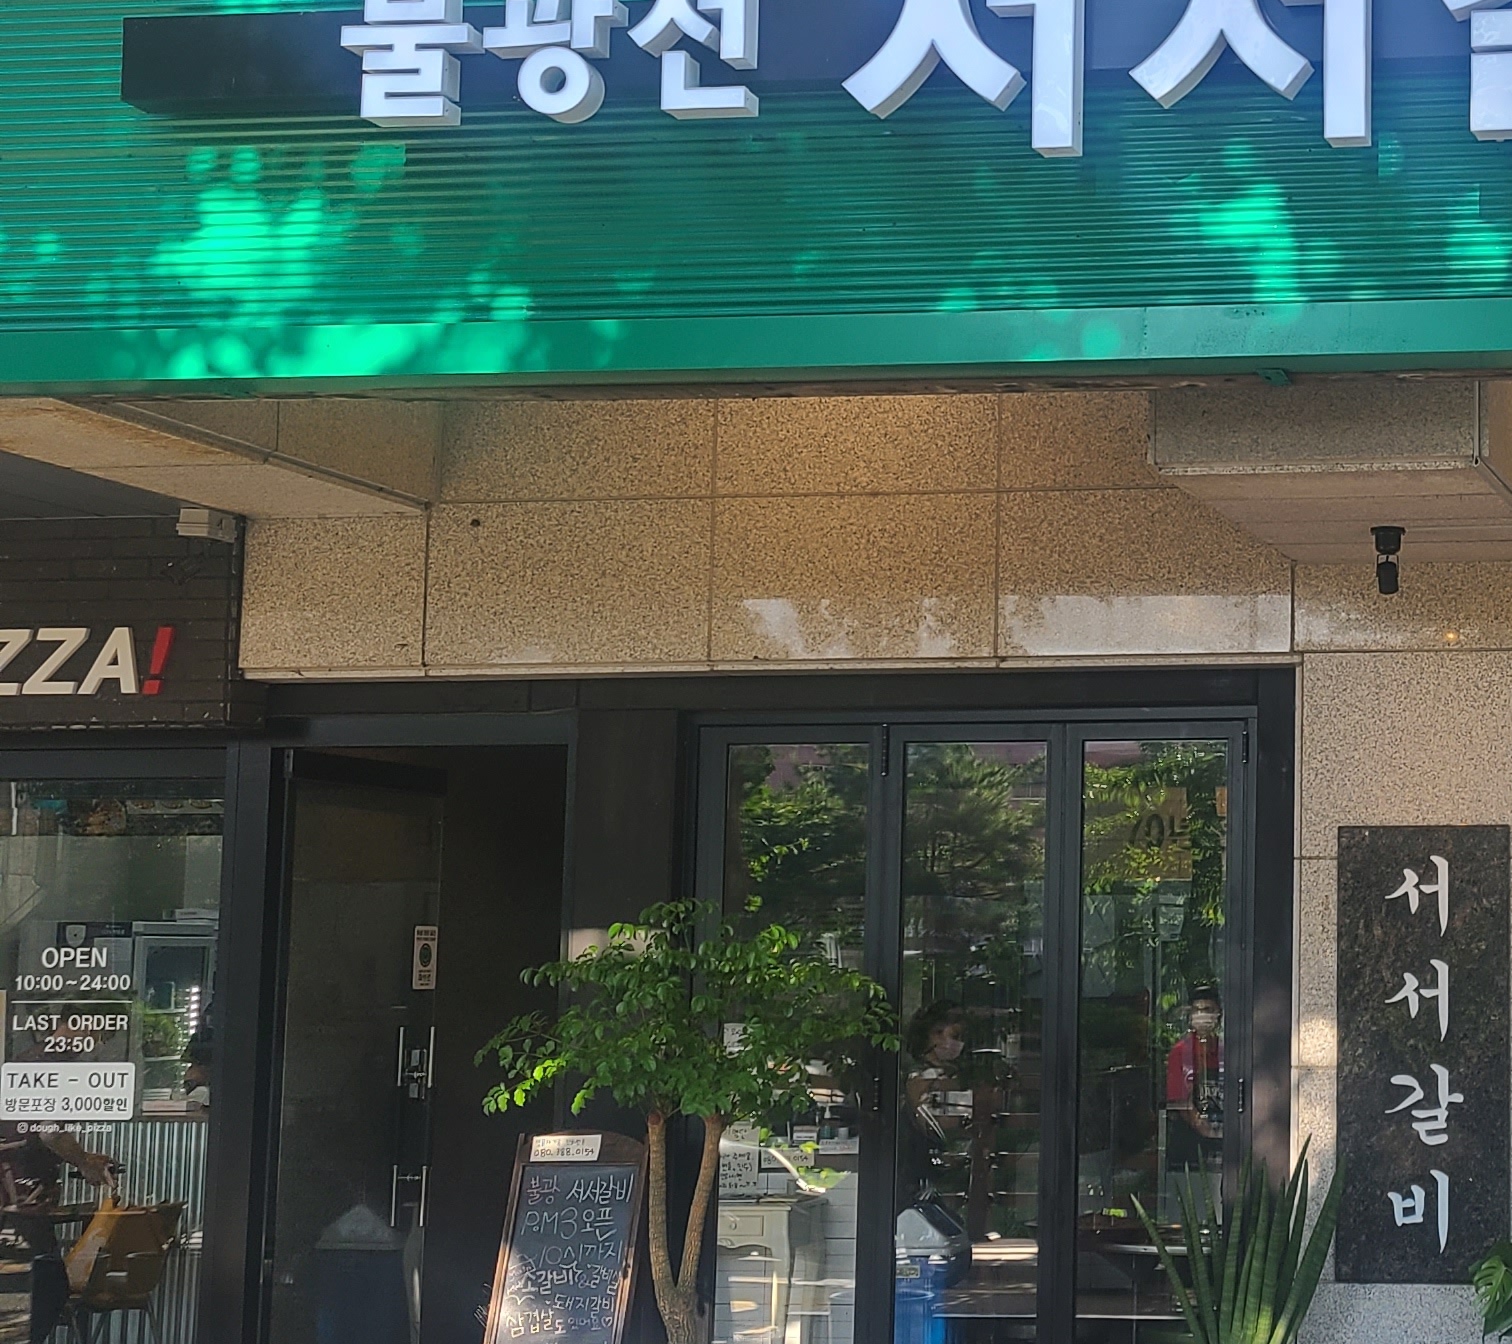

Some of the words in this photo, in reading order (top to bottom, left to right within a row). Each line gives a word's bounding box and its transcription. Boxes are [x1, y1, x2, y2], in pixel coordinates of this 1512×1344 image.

[41, 947, 108, 968] OPEN
[12, 1014, 61, 1031] LAST
[68, 1014, 129, 1031] ORDER
[44, 1036, 95, 1052] 23:50
[1385, 855, 1464, 1254] 서서갈비
[7, 1072, 60, 1088] TAKE
[88, 1072, 129, 1088] OUT
[5, 1097, 57, 1113] 방문포장
[527, 1175, 561, 1205] 불광
[566, 1173, 634, 1205] 서서갈비
